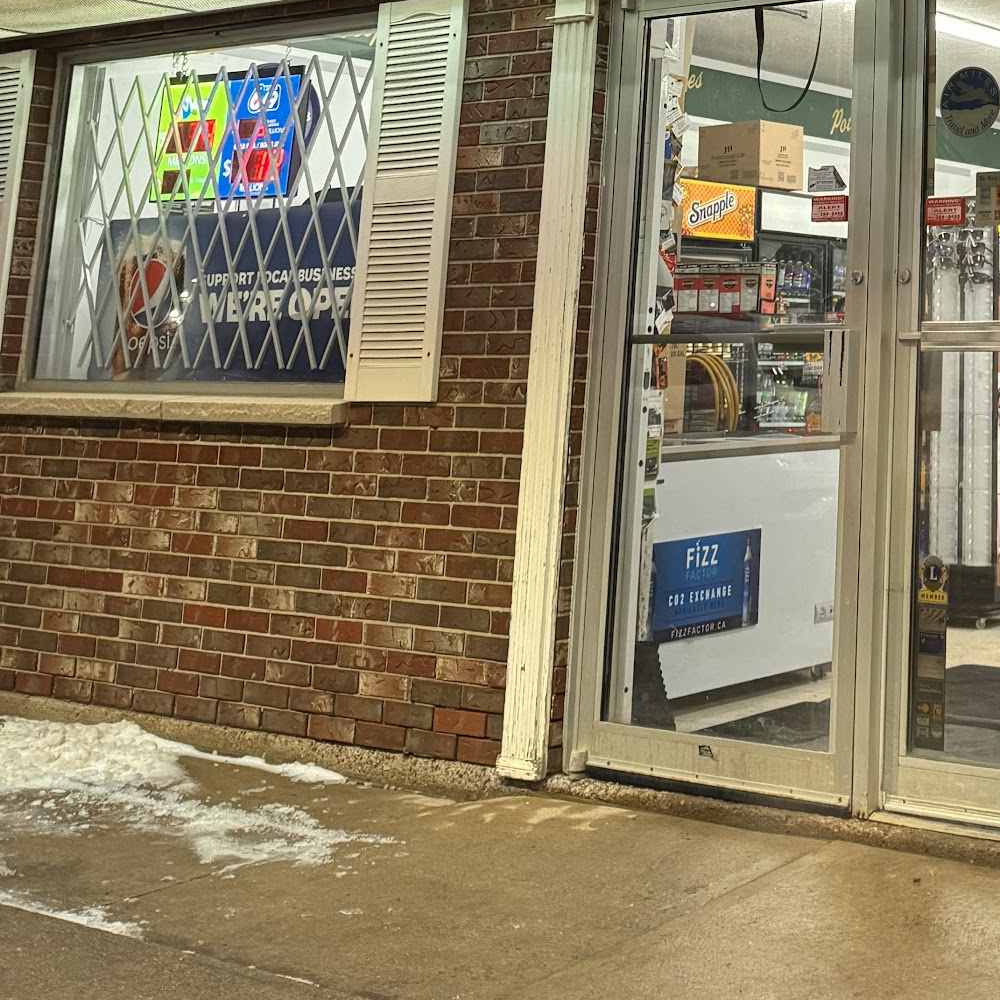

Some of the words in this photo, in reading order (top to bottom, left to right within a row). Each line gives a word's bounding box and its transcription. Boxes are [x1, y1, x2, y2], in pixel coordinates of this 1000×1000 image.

[959, 69, 998, 96] MILES
[688, 193, 735, 224] Snapple
[685, 567, 718, 581] FACTOR
[689, 585, 732, 603] EXCHANGE
